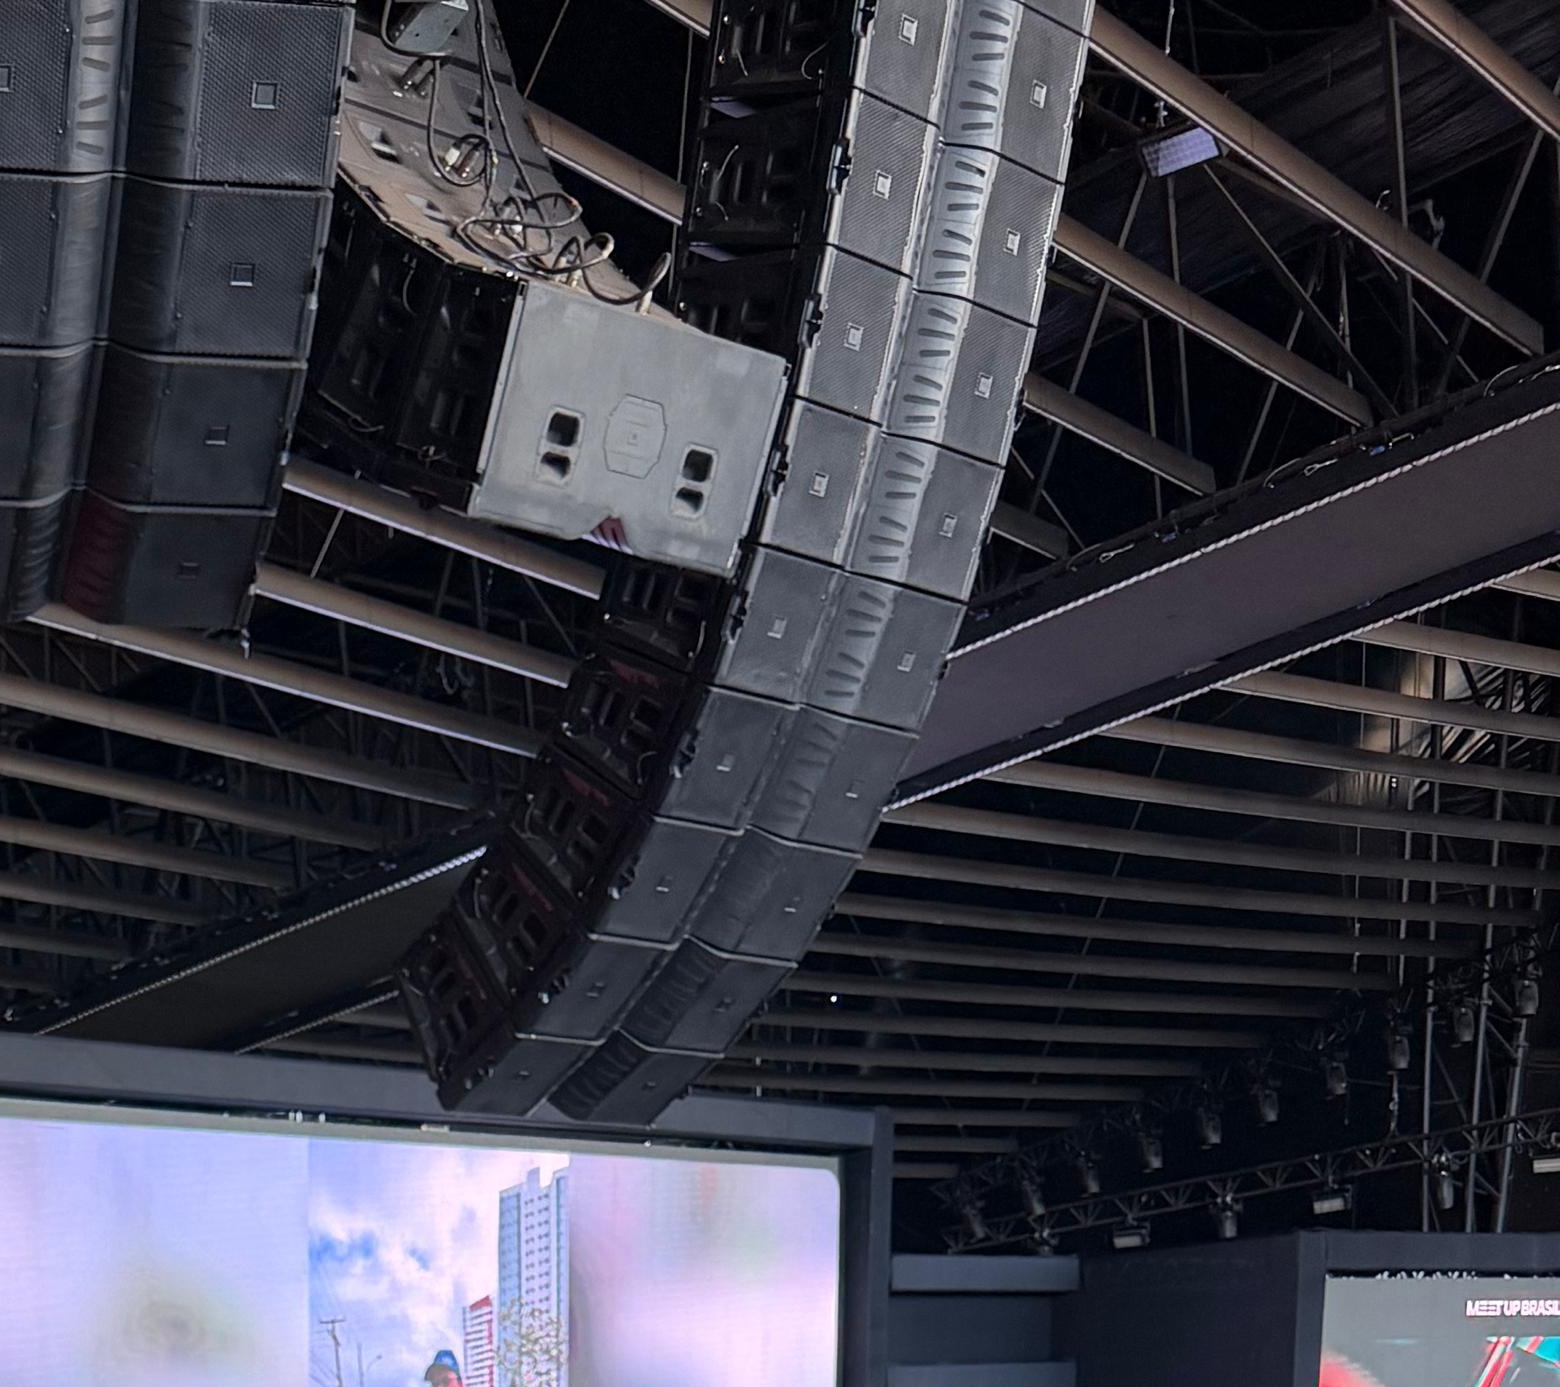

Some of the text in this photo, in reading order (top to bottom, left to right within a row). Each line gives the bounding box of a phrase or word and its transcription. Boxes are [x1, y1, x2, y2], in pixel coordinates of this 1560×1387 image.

[1465, 1299, 1560, 1317] MEET UP BRASIL
